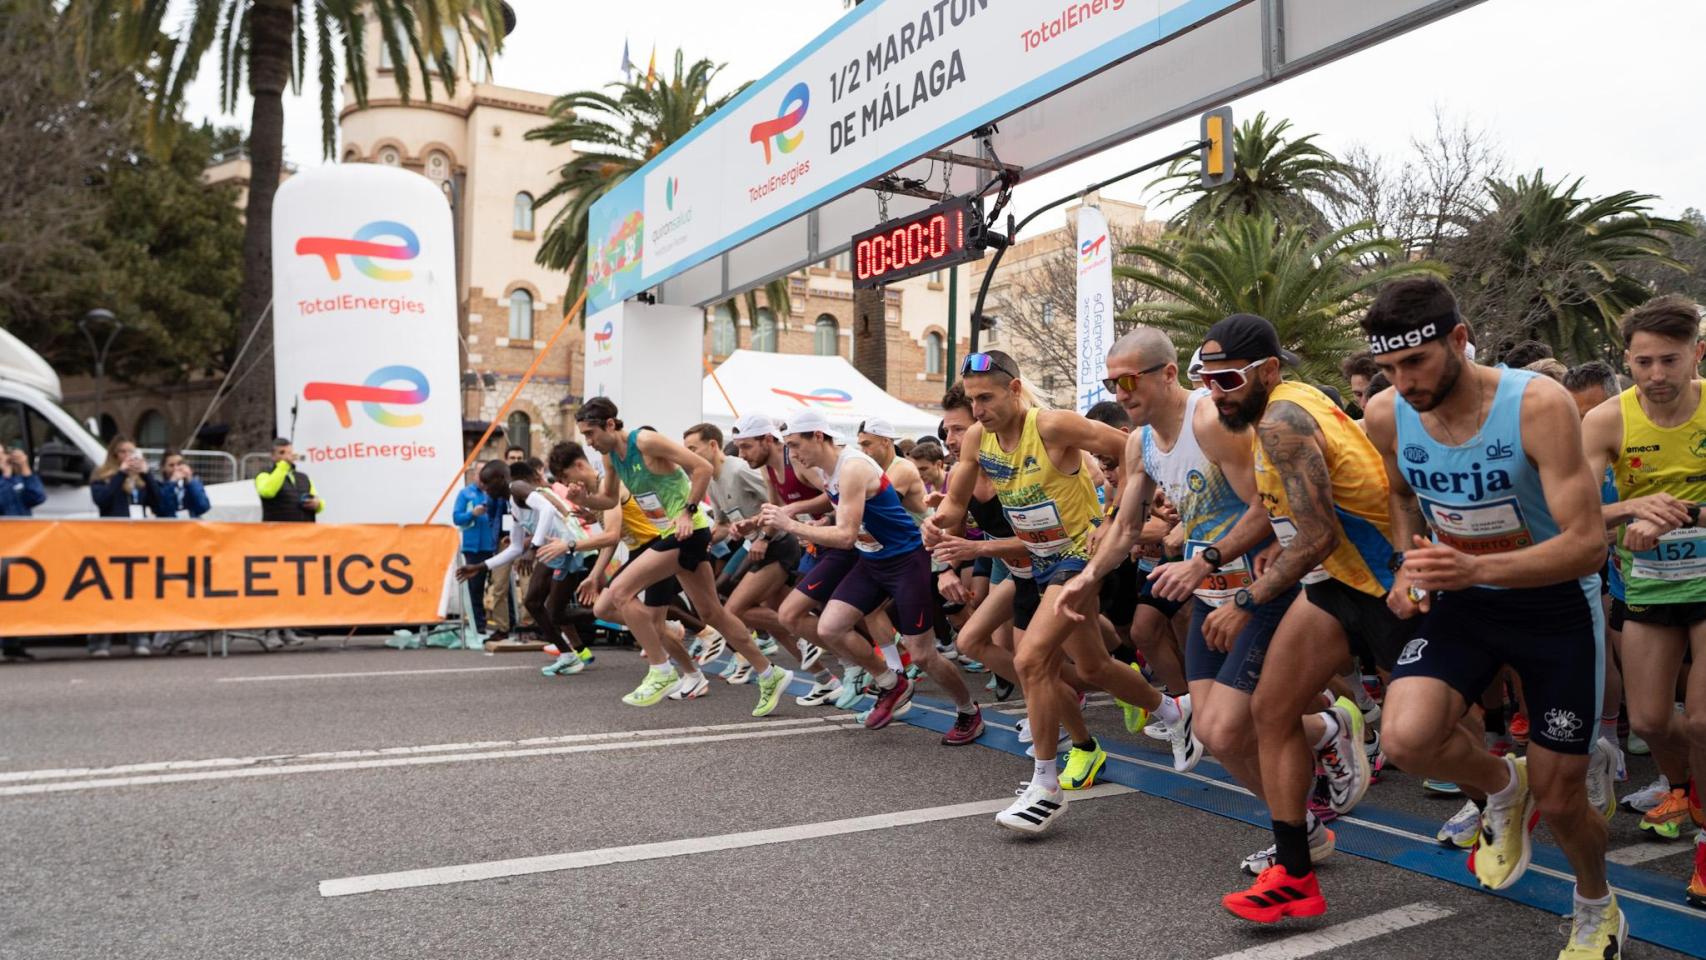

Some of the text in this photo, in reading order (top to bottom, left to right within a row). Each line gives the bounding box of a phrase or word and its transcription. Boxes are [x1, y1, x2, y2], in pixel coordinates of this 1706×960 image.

[829, 57, 861, 104] 1/2
[830, 111, 856, 155] DE
[862, 48, 966, 138] MÁLAGA
[748, 159, 810, 203] TotalEnergies
[857, 208, 964, 280] 00:00:01
[298, 294, 426, 316] TotalEnergies
[306, 441, 436, 463] TotalEnergies
[1406, 462, 1514, 502] nerja
[1652, 541, 1697, 561] 152
[1, 556, 46, 601] D
[64, 552, 414, 601] ATHLETICS
